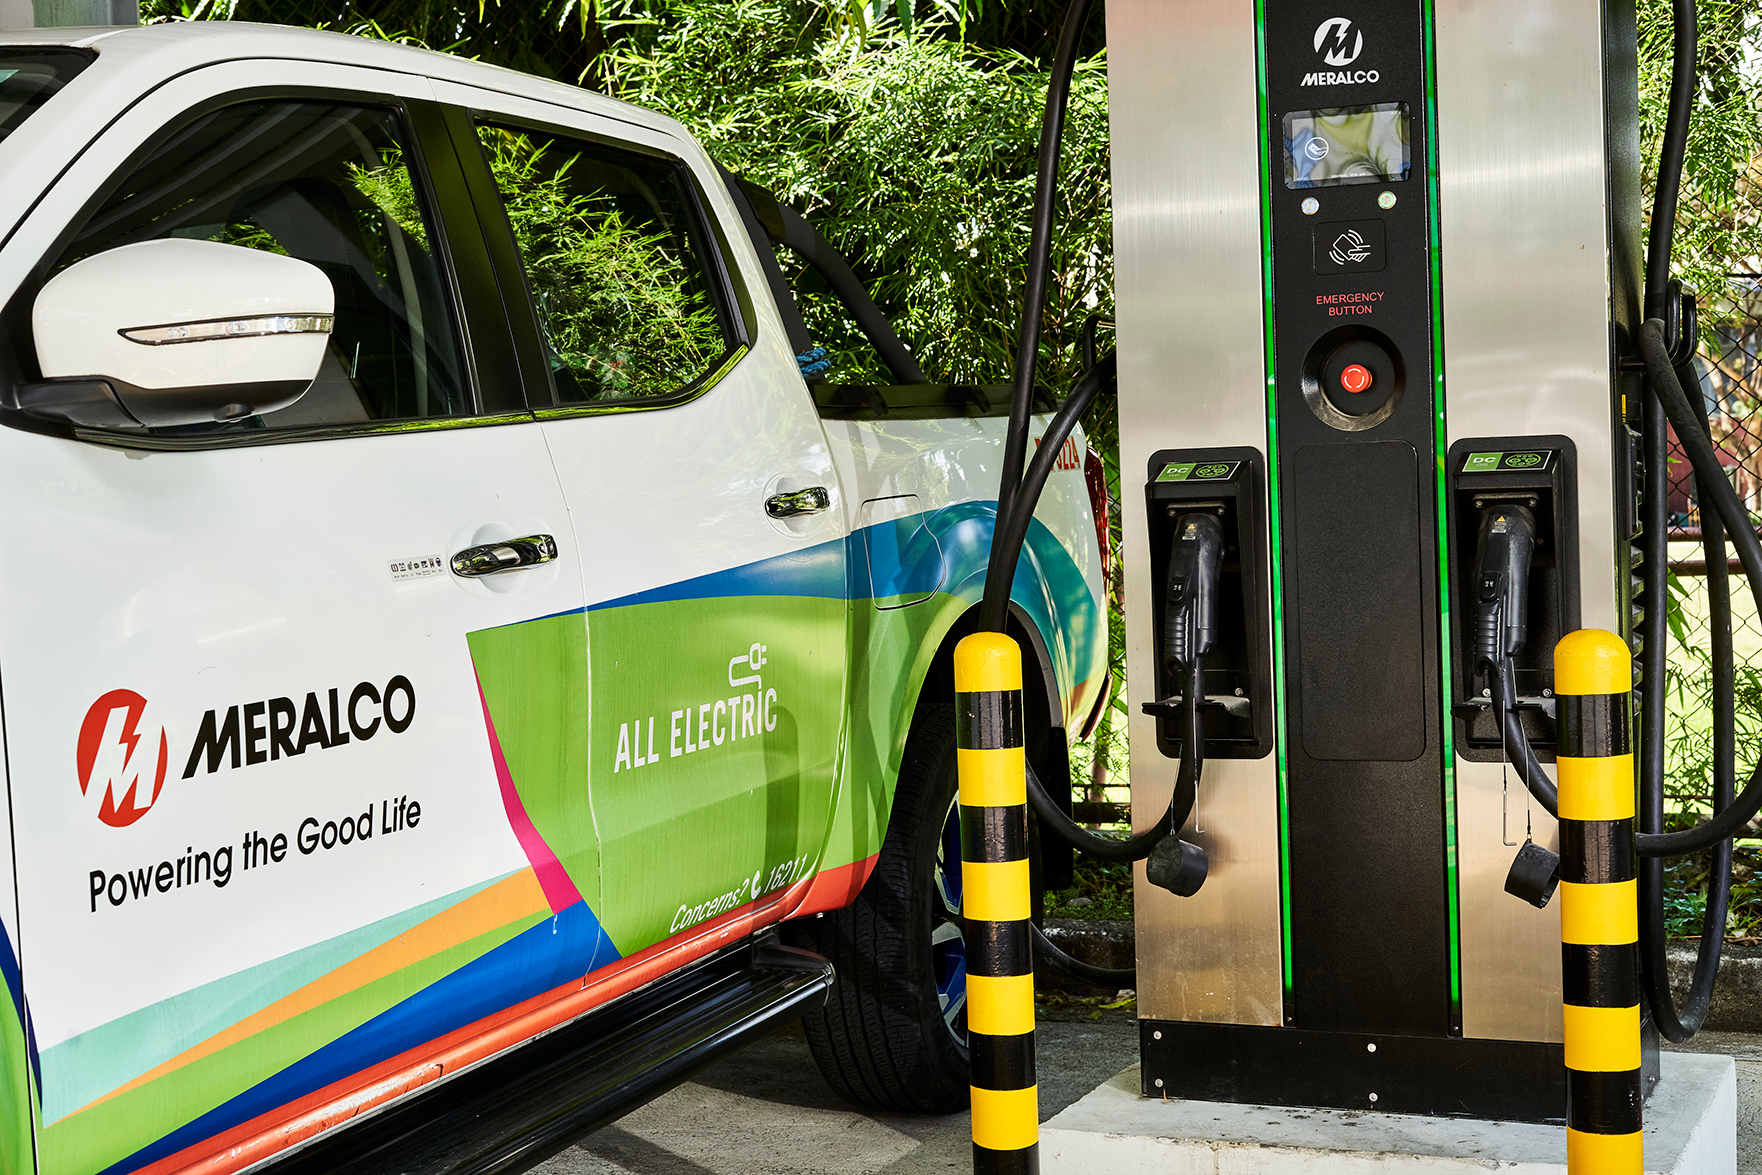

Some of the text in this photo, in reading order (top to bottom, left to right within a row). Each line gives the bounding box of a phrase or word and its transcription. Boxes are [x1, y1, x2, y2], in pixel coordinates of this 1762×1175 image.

[1300, 69, 1380, 87] MERALCO
[1315, 291, 1385, 305] EMERGENCY
[1328, 304, 1373, 317] BUTTON
[182, 674, 416, 780] MERALCO
[613, 687, 778, 774] ALL ELECTRIC
[89, 794, 421, 913] Powering the Good Life
[669, 853, 808, 934] Concerns? 16211
